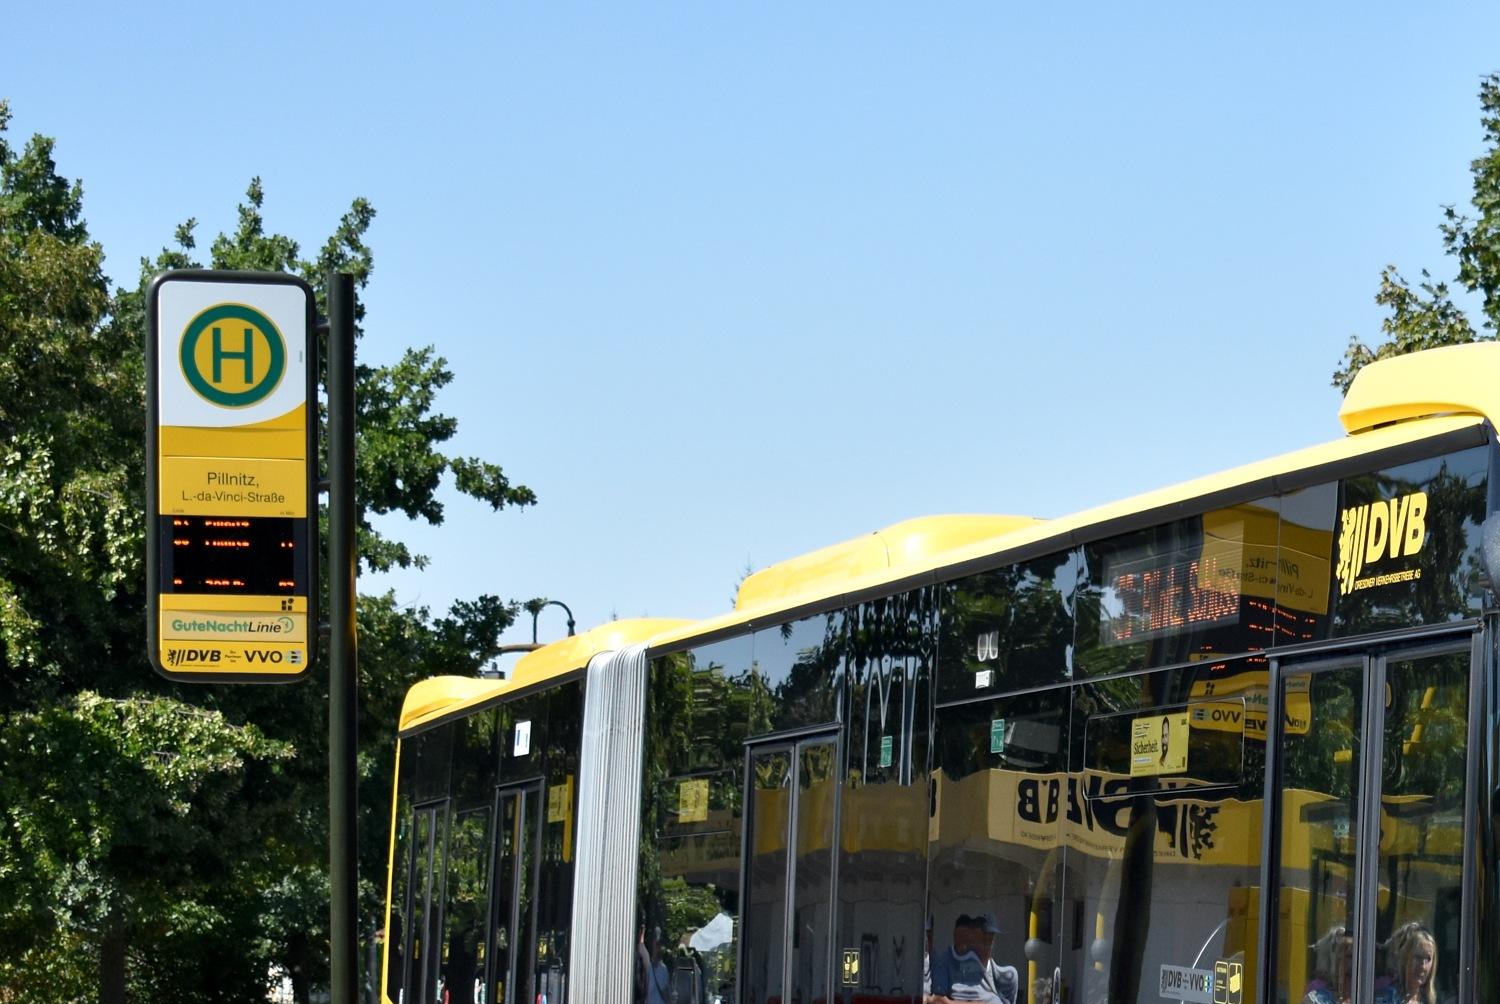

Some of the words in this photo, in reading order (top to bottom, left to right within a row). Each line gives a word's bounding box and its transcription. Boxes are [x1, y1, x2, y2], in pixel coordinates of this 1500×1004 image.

[207, 471, 260, 487] Pillnitz,
[181, 490, 286, 504] L.-da-Vinci-Straße
[1365, 492, 1428, 564] DVB
[171, 619, 282, 634] GuteNachtLinie
[186, 649, 222, 662] DVB
[244, 649, 283, 664] VVO
[1168, 970, 1183, 988] DVB
